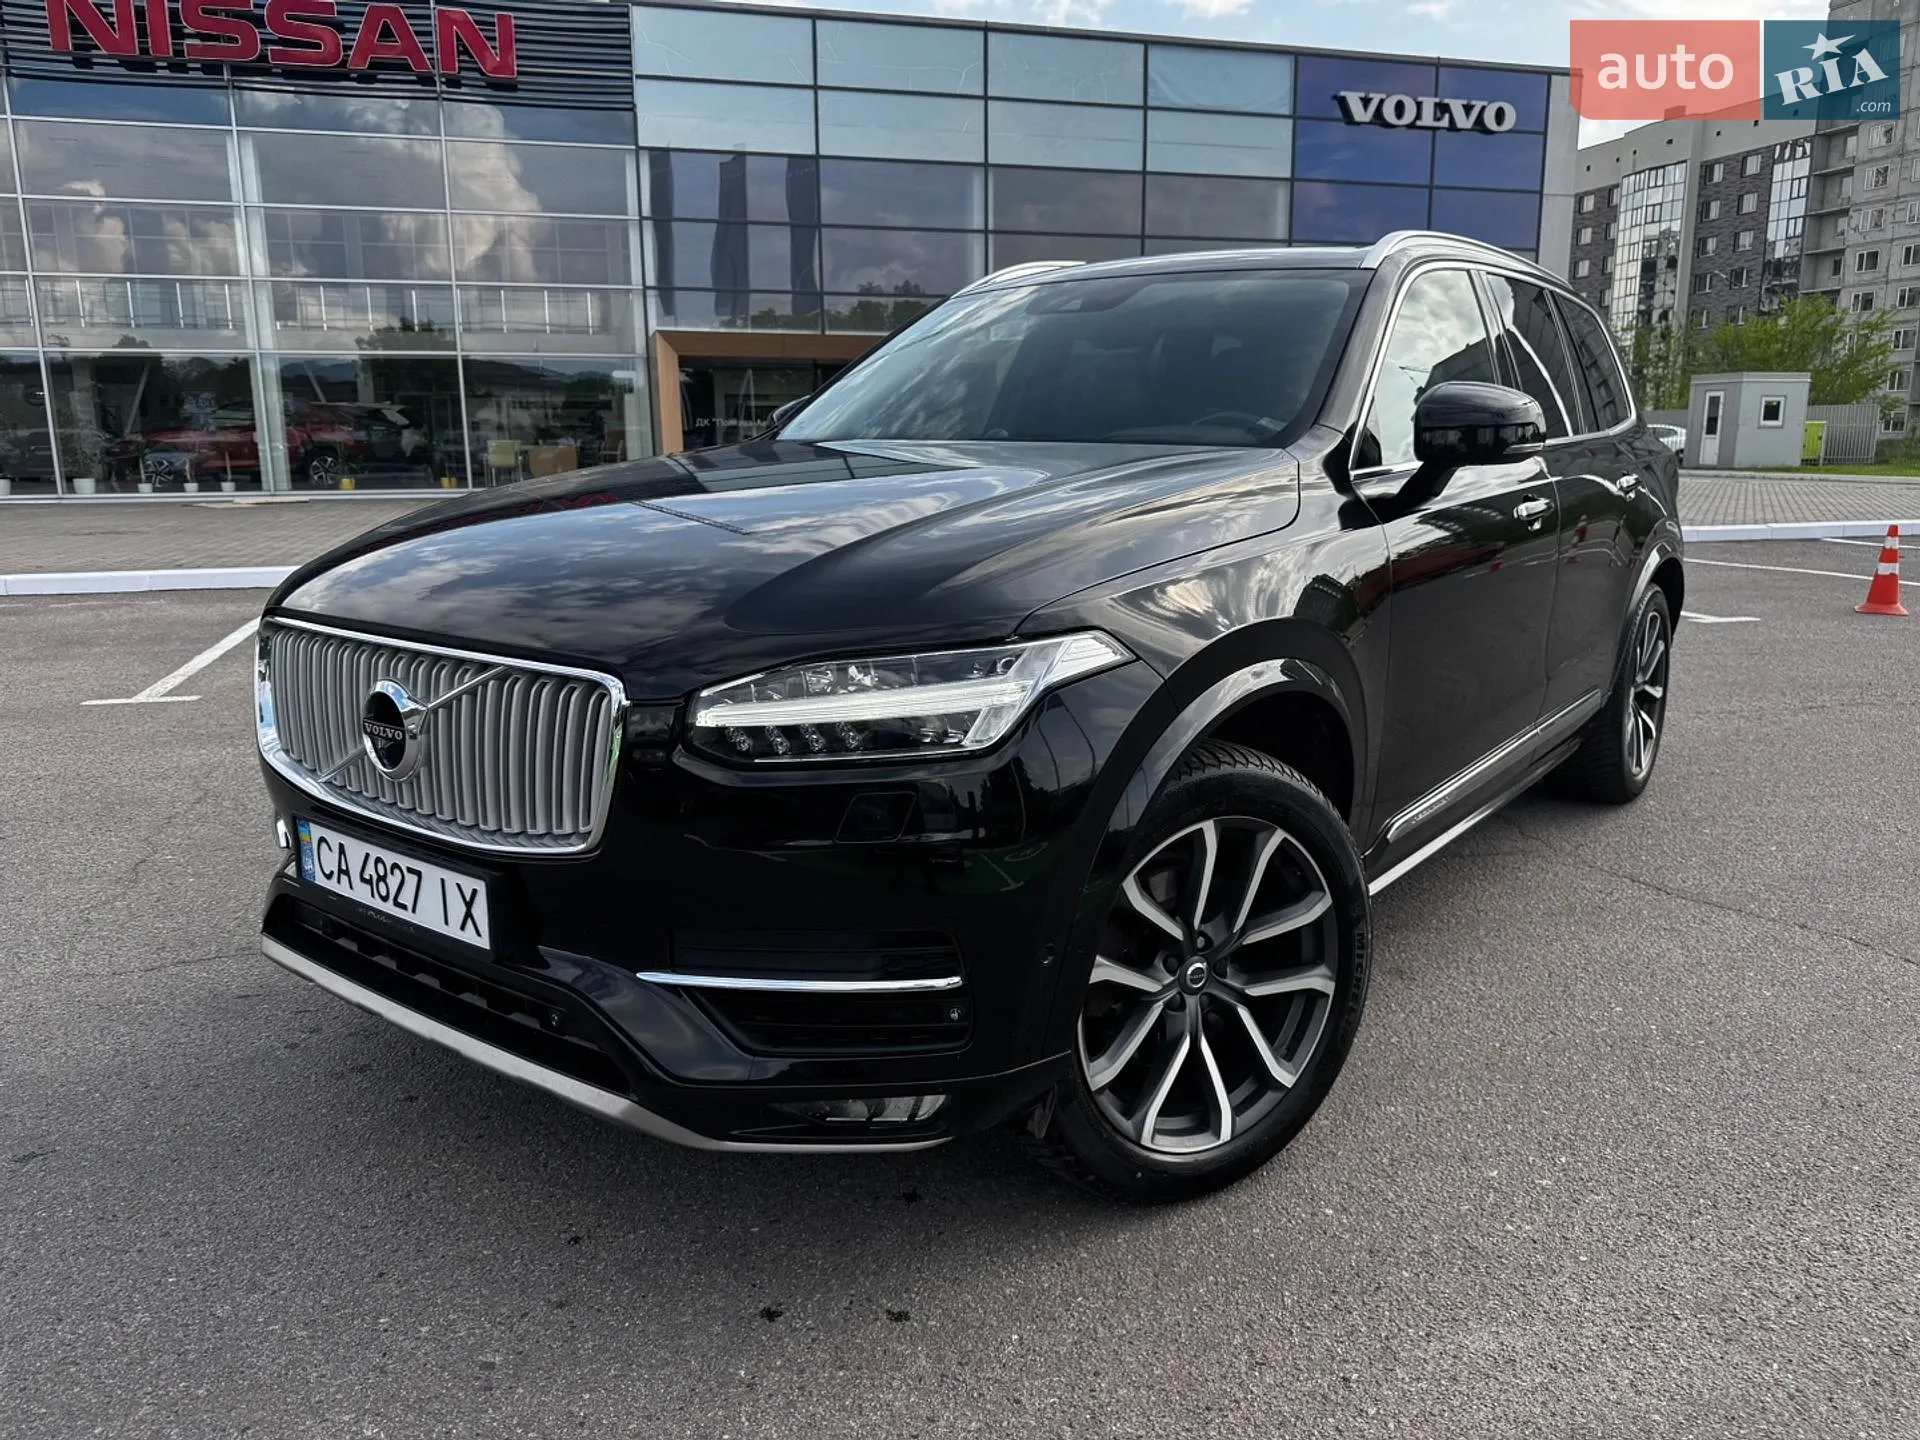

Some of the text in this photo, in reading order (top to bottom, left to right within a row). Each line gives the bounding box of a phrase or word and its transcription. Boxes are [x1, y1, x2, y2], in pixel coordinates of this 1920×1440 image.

[46, 0, 518, 79] NISSAN
[1339, 90, 1517, 132] VOLVO
[363, 722, 403, 741] VOLVO
[317, 836, 354, 890] CA
[359, 852, 422, 914] 4827
[440, 877, 482, 938] IX
